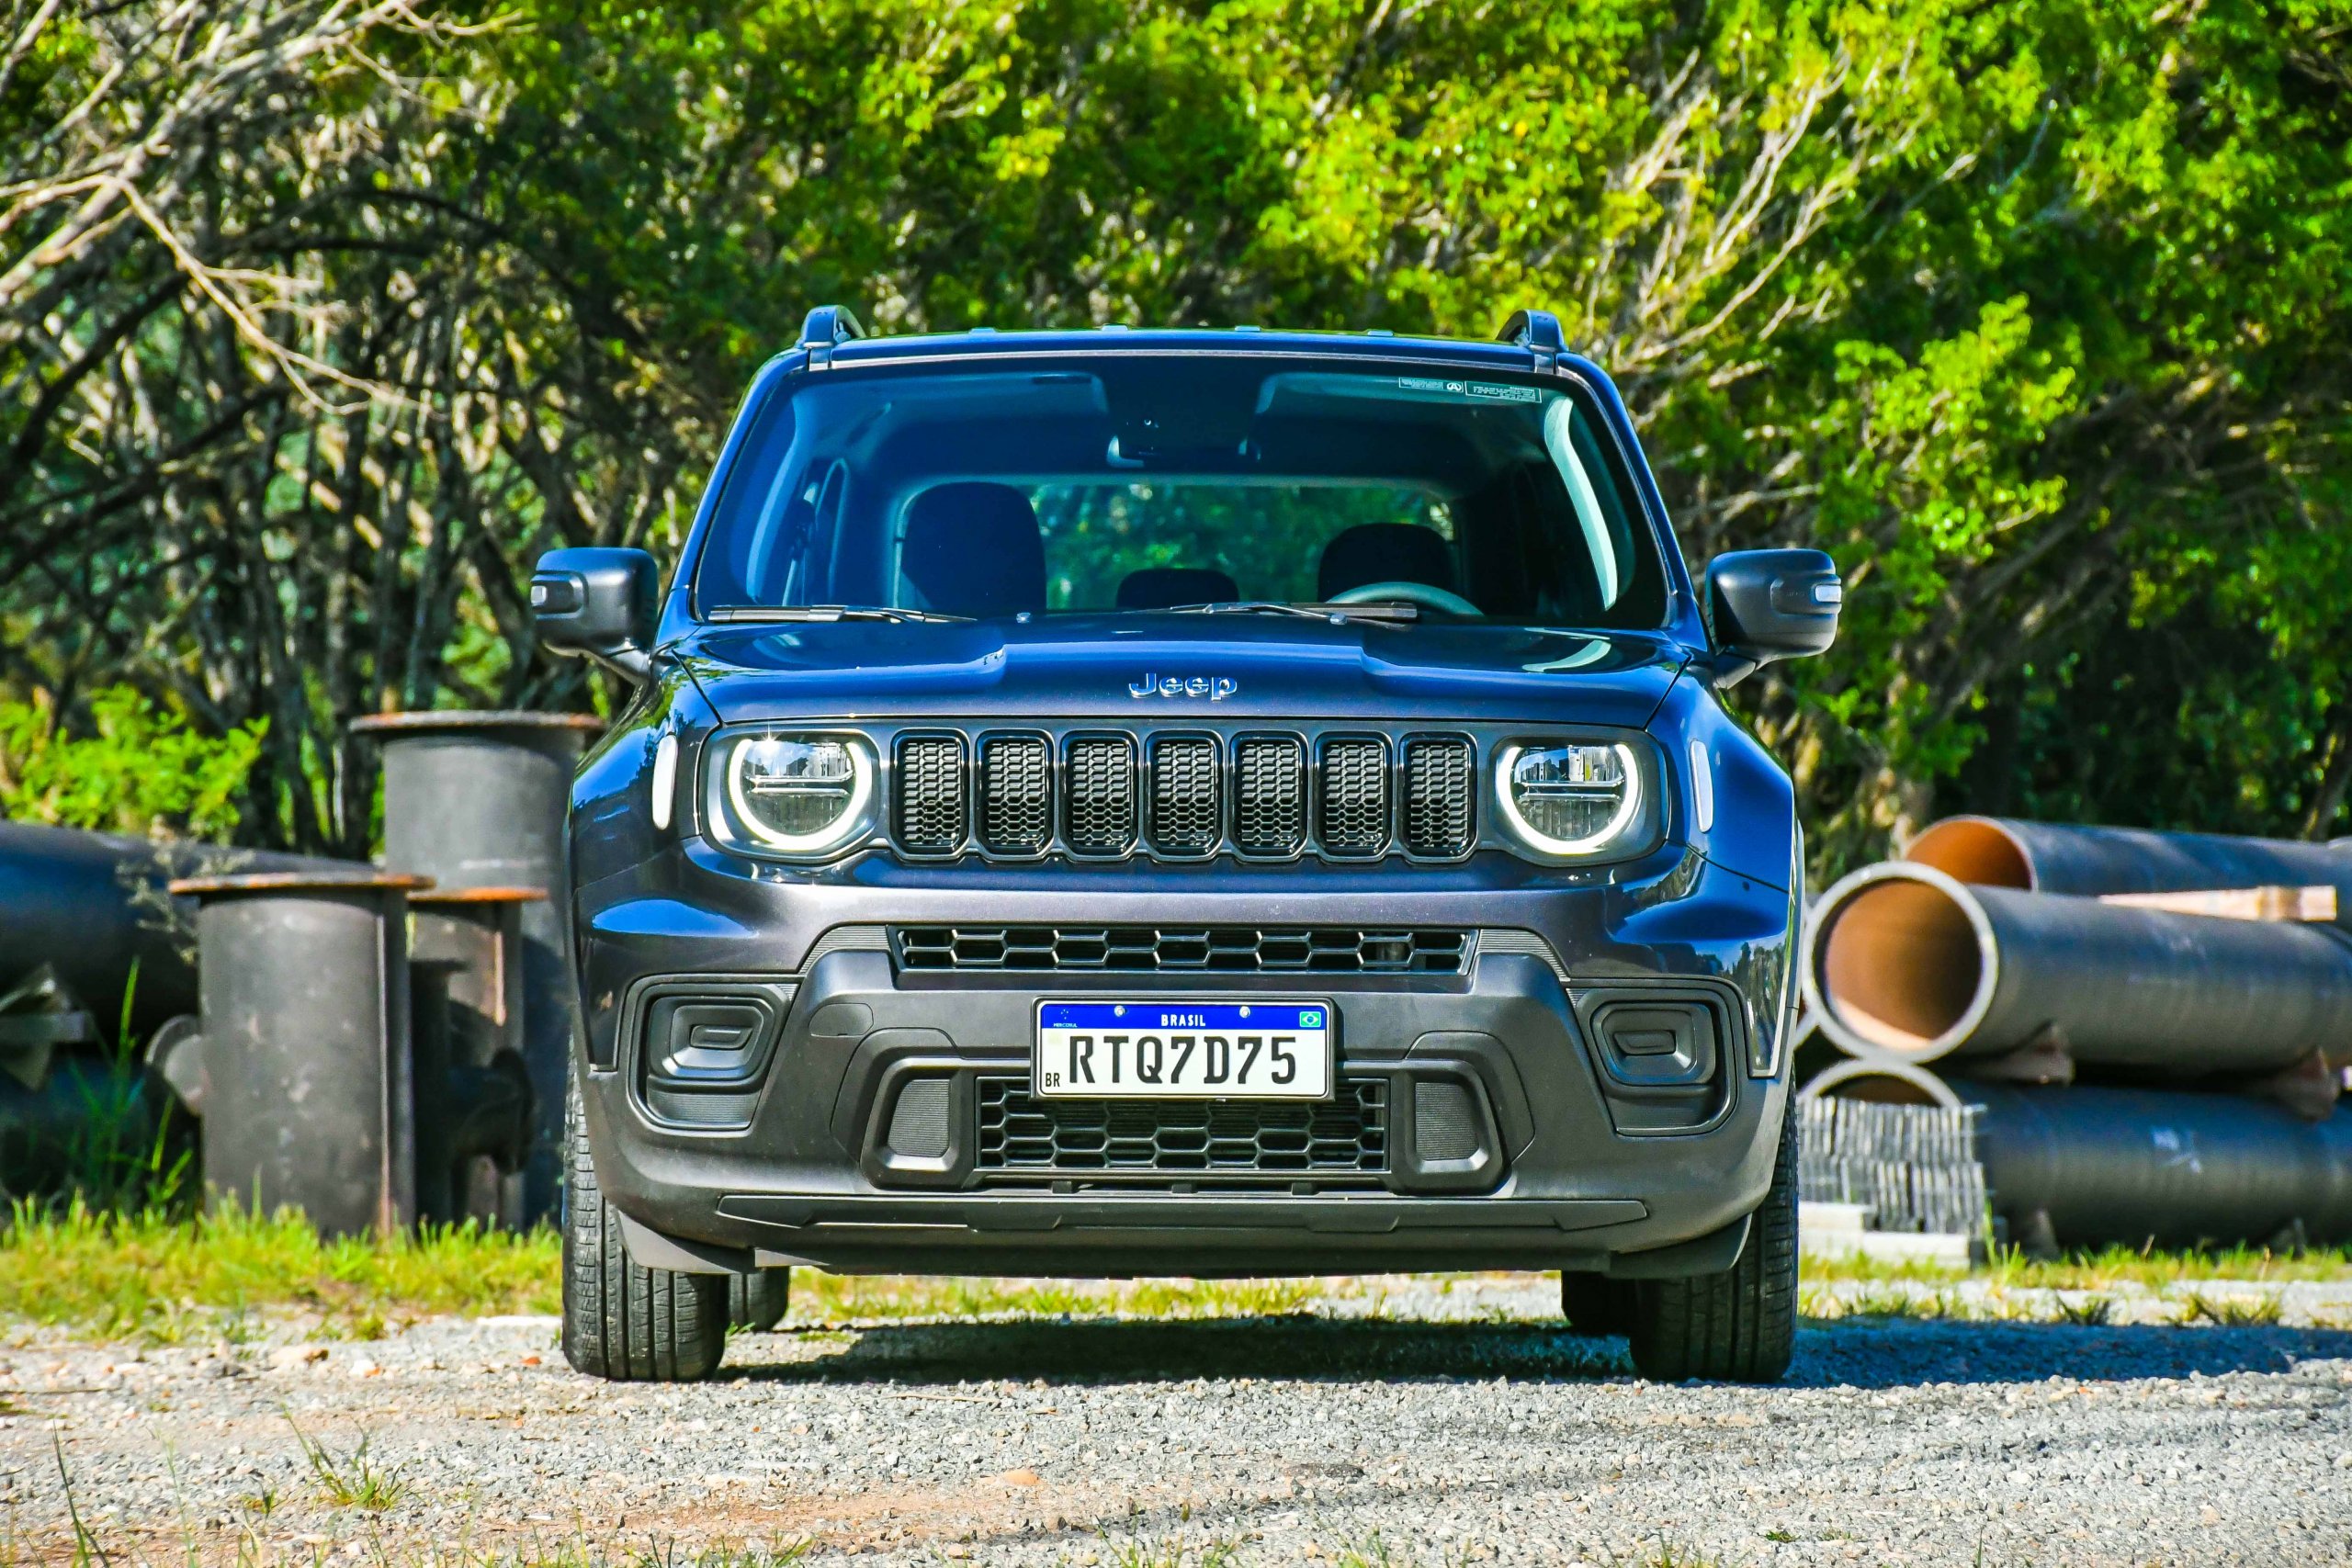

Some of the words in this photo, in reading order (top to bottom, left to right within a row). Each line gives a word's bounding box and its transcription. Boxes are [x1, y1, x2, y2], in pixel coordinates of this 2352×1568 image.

[1128, 672, 1238, 701] Jeep
[1160, 1013, 1206, 1027] BRASIL
[1069, 1035, 1296, 1085] RTQ7D75
[1045, 1072, 1060, 1088] BR
